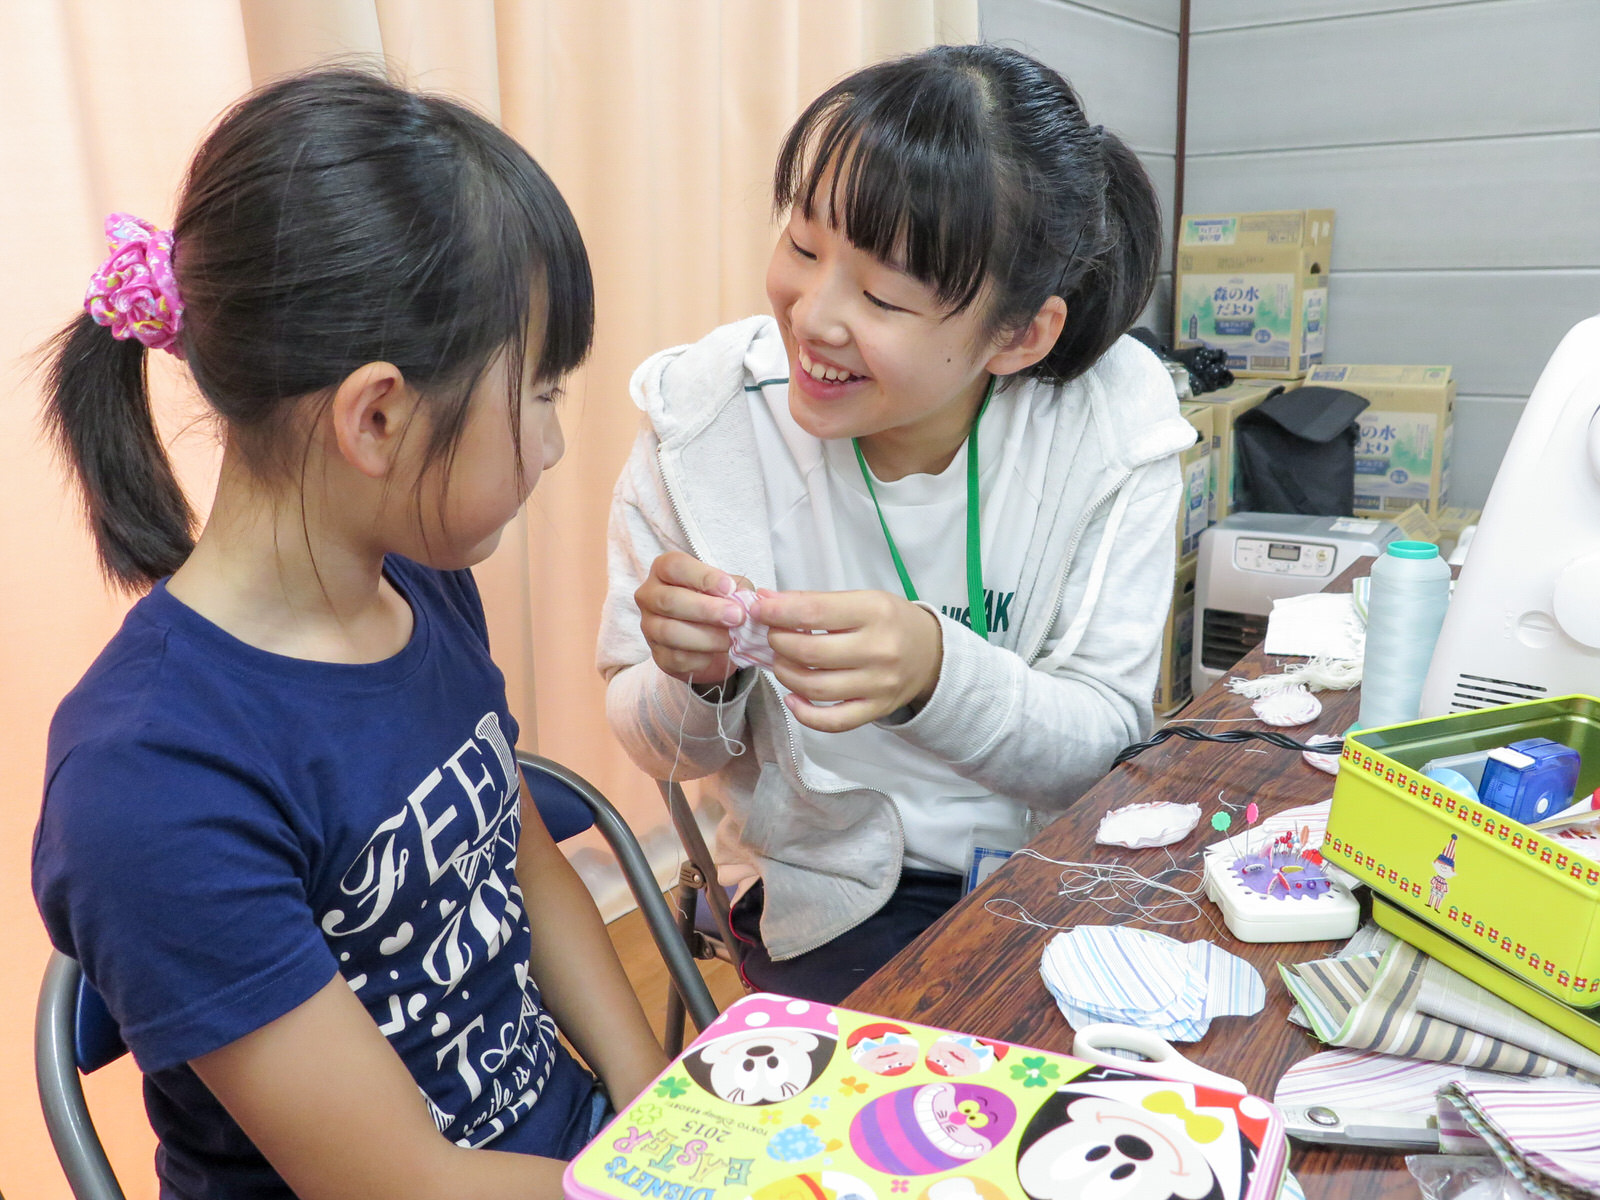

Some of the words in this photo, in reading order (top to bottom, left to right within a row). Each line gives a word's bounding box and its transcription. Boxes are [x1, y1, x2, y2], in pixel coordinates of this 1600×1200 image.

[1213, 286, 1260, 302] 森の水
[1216, 303, 1255, 316] だより
[1358, 424, 1397, 441] の水
[681, 1119, 733, 1144] 2015
[736, 1121, 769, 1137] TOKYO
[612, 1126, 756, 1186] EASTER
